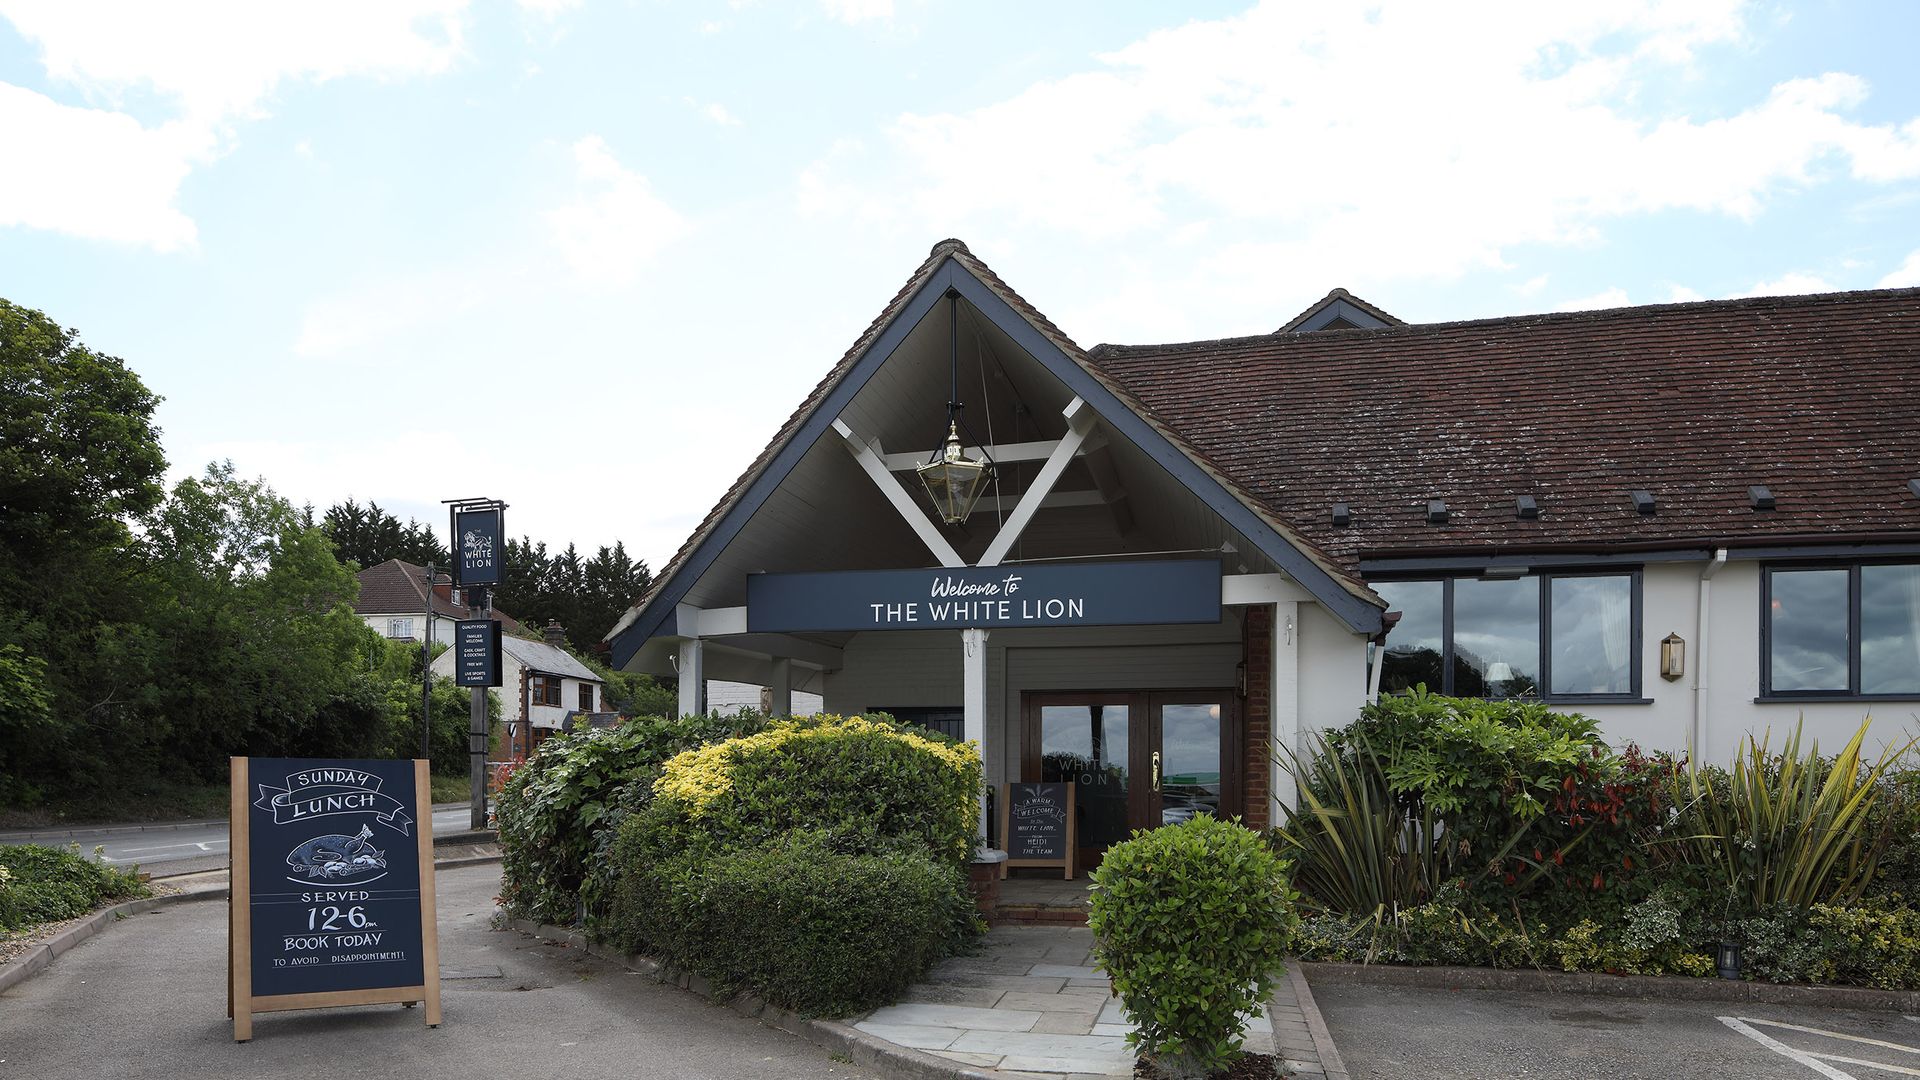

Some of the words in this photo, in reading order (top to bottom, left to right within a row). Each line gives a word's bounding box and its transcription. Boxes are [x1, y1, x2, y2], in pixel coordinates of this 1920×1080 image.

[464, 549, 492, 559] WHITE
[465, 559, 492, 568] LION
[931, 576, 1001, 598] Welcome
[1002, 573, 1022, 597] to
[870, 602, 919, 623] THE
[929, 600, 1010, 622] WHITE
[1022, 598, 1084, 620] LION
[1058, 759, 1108, 771] WHIT
[298, 770, 370, 788] SUNDAY
[292, 794, 376, 818] LUNCH
[1021, 807, 1054, 816] WELCOME
[301, 890, 370, 903] SERVED
[284, 935, 329, 951] BOOK
[334, 932, 383, 949] TODAY
[274, 958, 286, 966] TO
[291, 956, 320, 966] AVOID
[331, 950, 405, 963] DISAPPOINTMENT!
